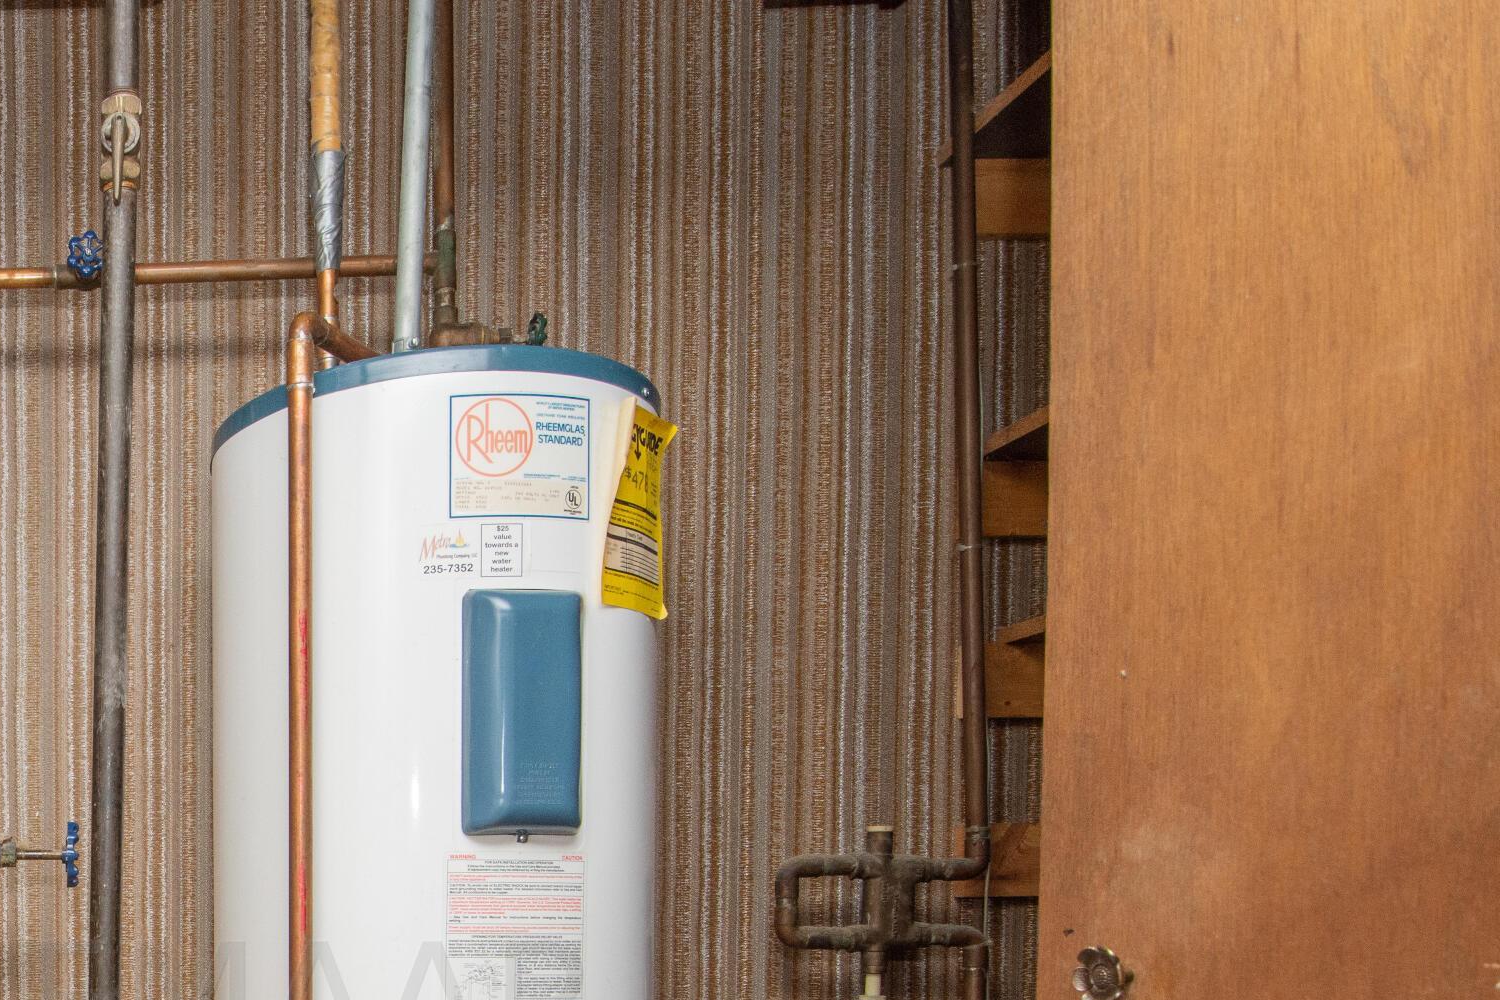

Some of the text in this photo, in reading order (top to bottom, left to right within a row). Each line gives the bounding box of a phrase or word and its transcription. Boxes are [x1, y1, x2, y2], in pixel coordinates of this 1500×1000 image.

[466, 400, 528, 464] Rheem
[538, 434, 583, 446] STANDARD
[423, 563, 474, 574] 235-7352
